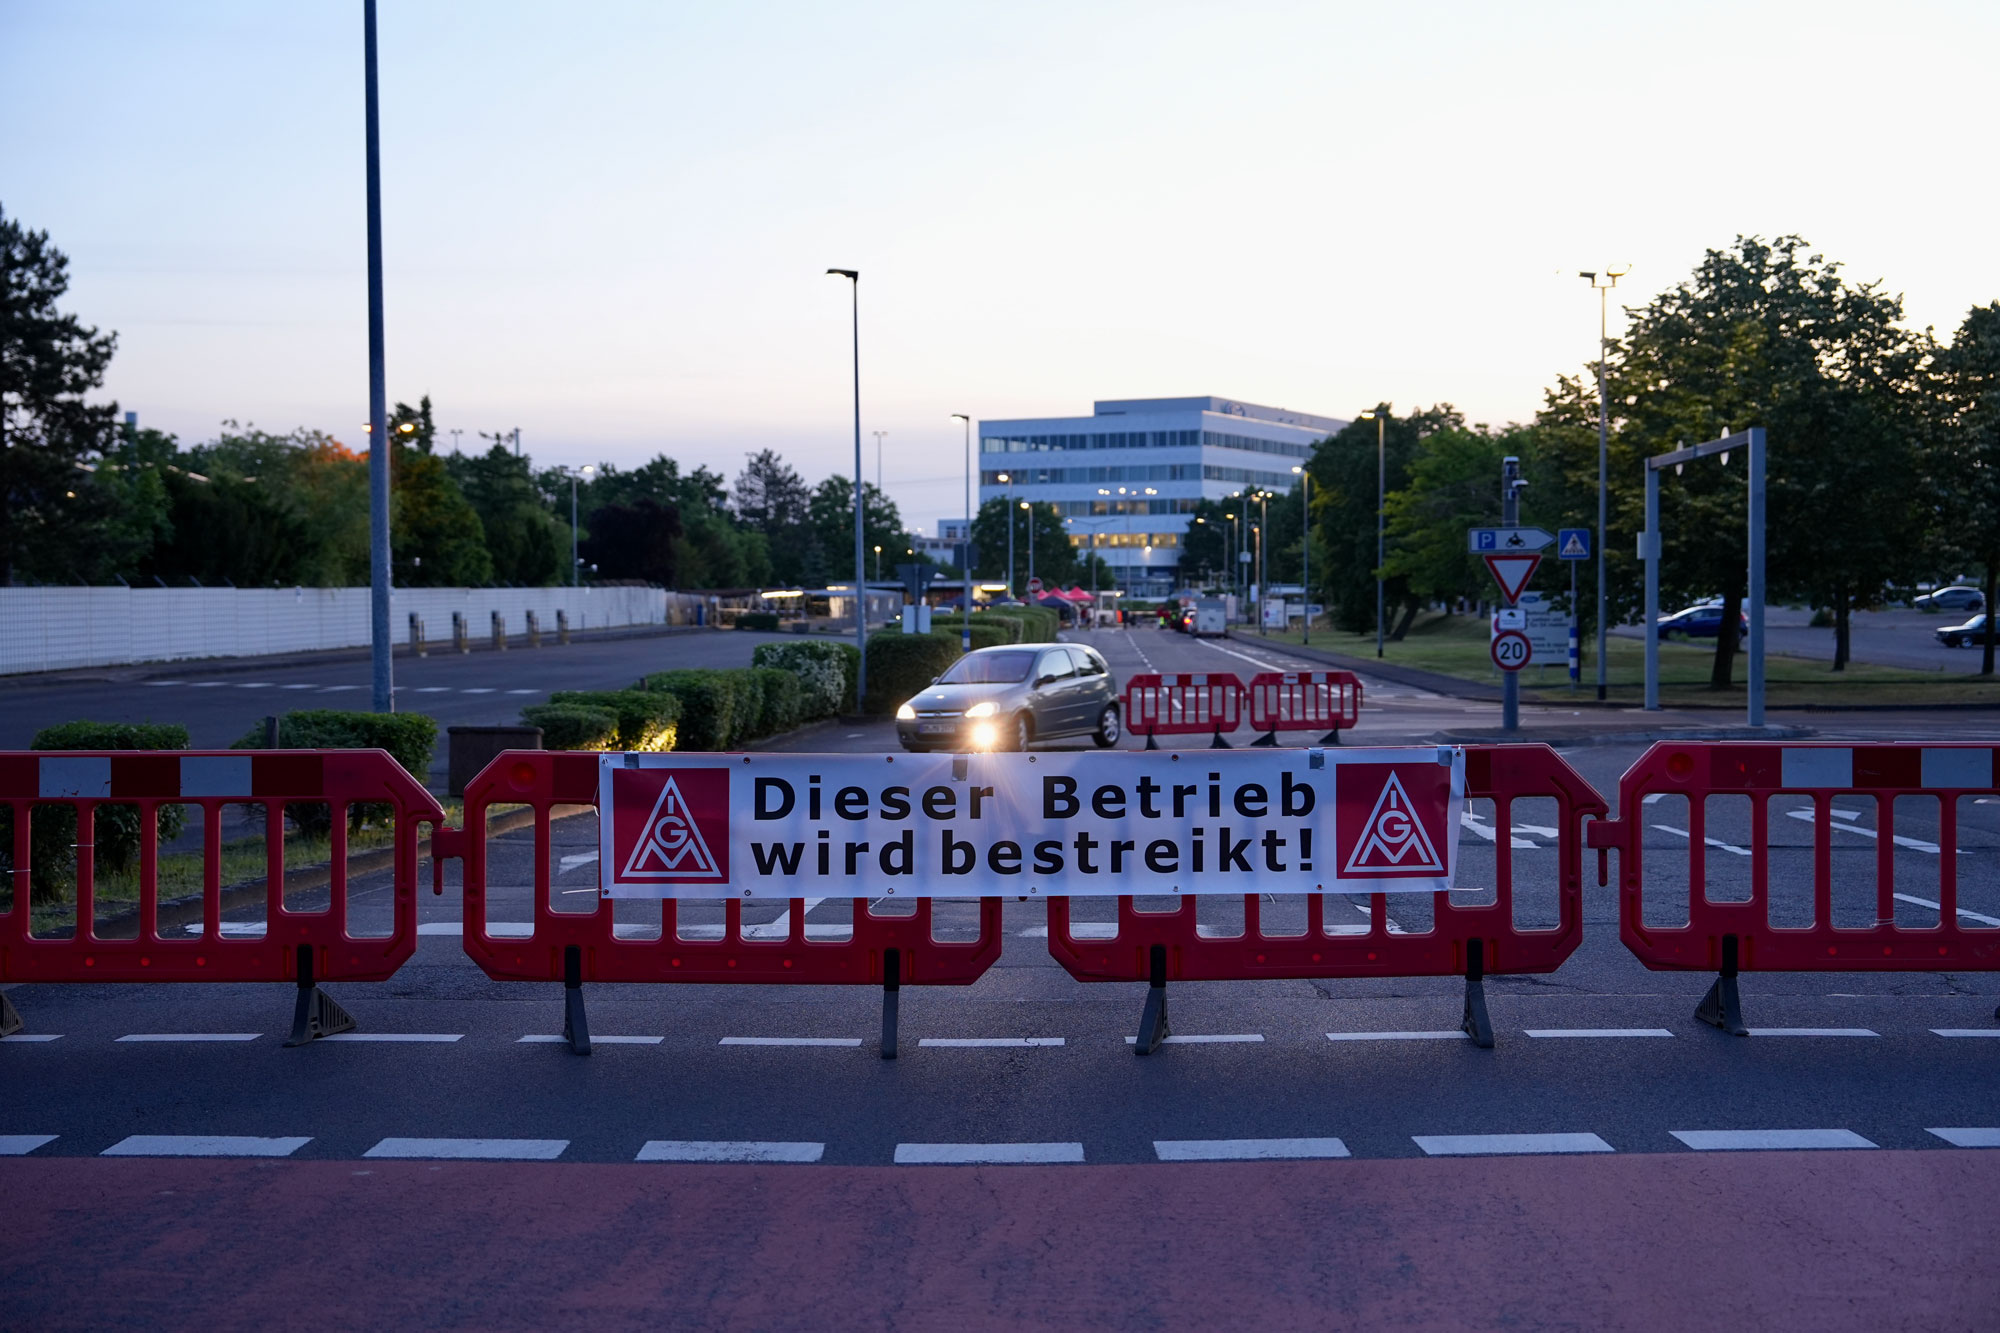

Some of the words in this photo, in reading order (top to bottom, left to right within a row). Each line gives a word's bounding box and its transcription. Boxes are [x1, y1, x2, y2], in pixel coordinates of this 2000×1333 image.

[1481, 533, 1492, 548] P
[1500, 642, 1523, 660] 20
[755, 775, 993, 821] Dieser
[1043, 772, 1315, 819] Betrieb
[750, 829, 913, 876] wird
[942, 828, 1312, 876] bestreikt!
